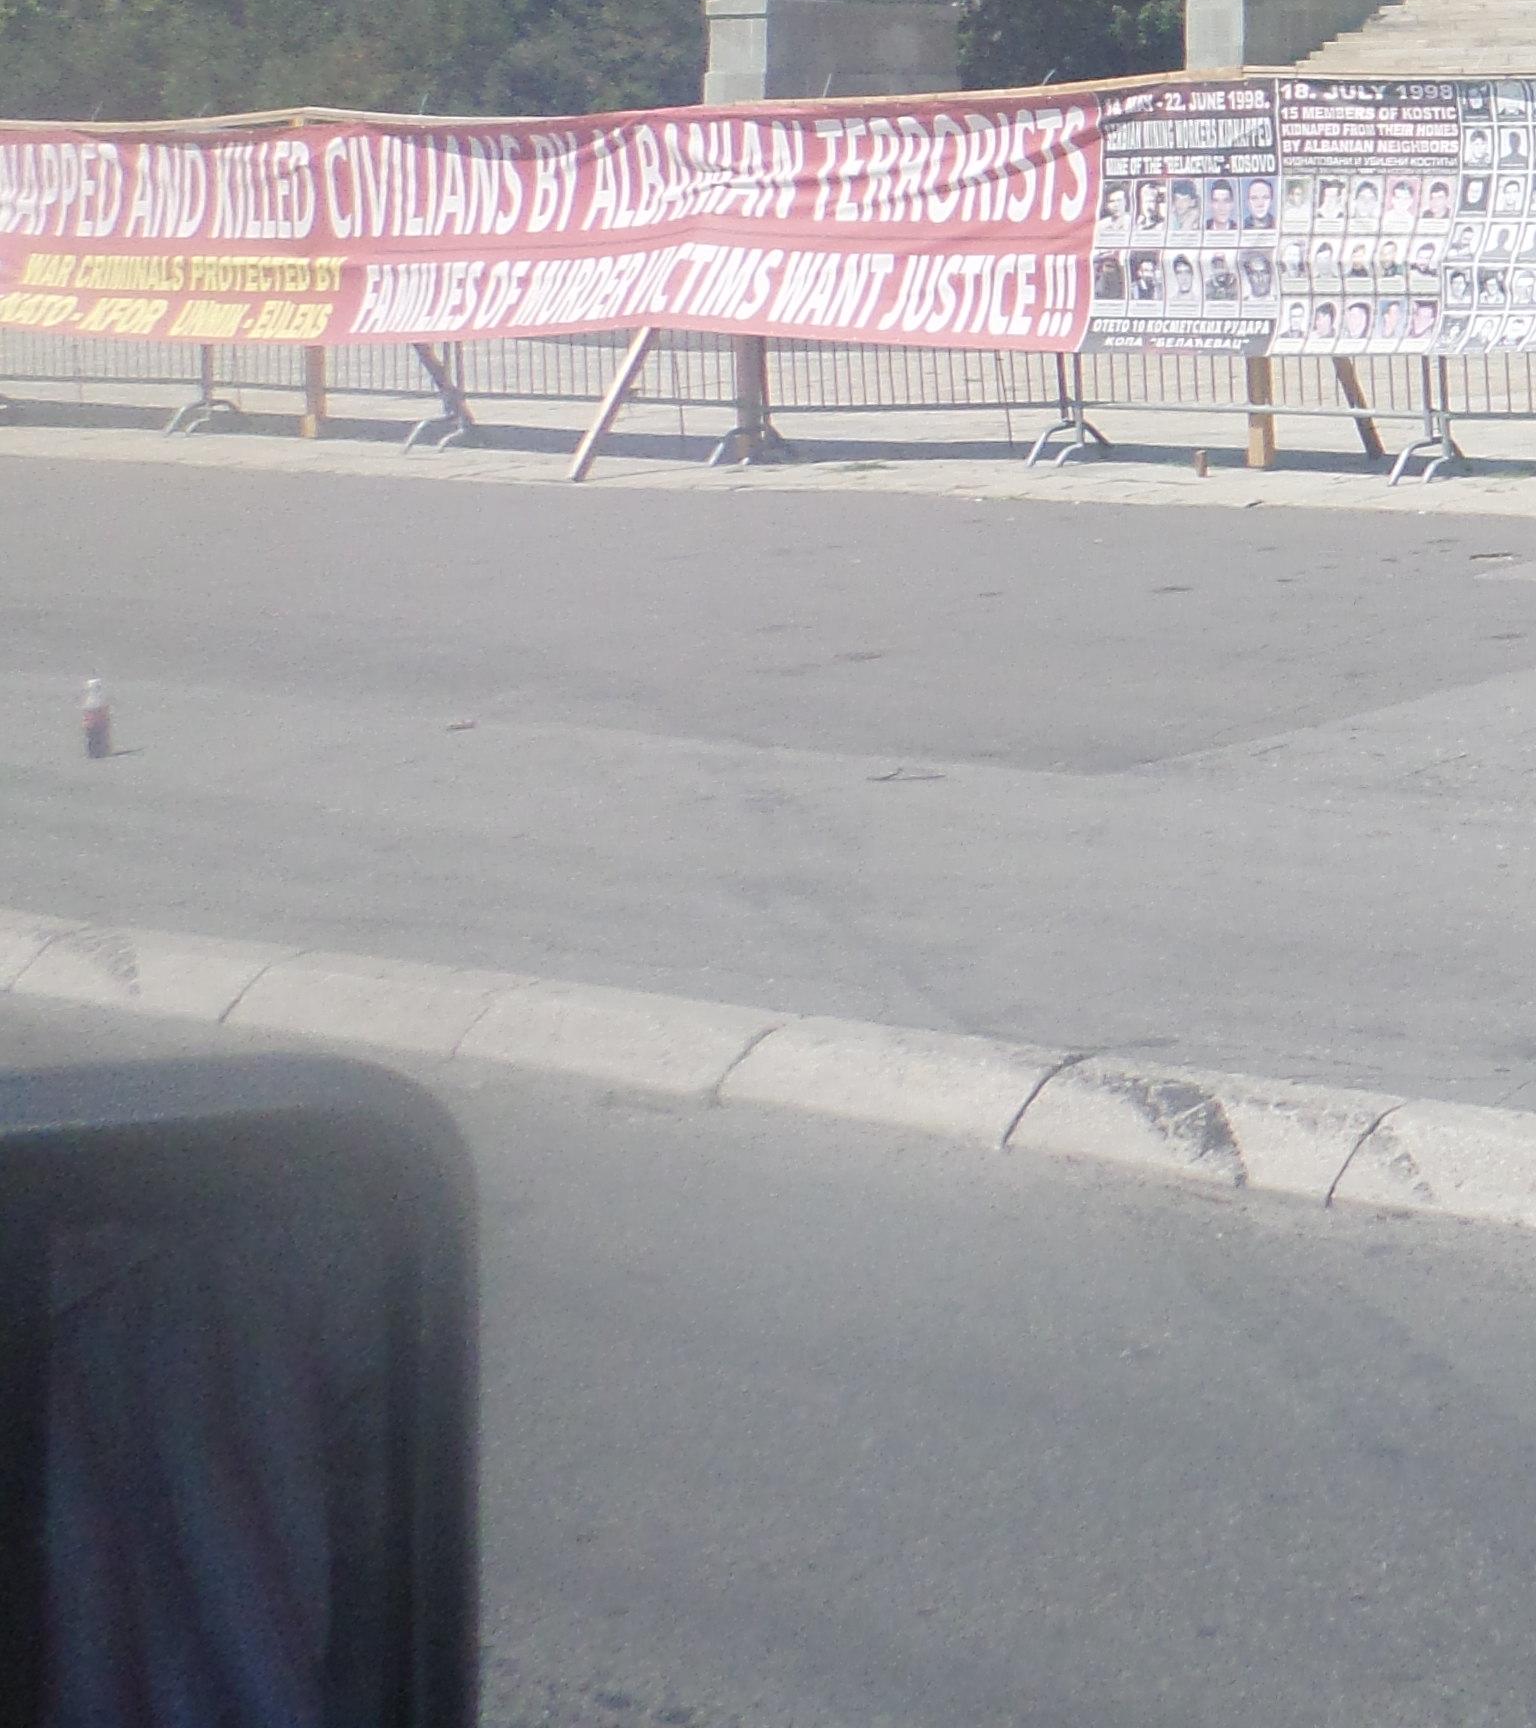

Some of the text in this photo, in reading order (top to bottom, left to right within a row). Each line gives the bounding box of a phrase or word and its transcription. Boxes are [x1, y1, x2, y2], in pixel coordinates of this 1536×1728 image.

[1164, 92, 1186, 111] 22.
[1188, 91, 1226, 111] JUNE
[1227, 89, 1270, 110] 1998.
[1281, 83, 1454, 101] 18. JULY 1998
[1281, 106, 1457, 121] 15 MEMBERS OF KOSTIC
[1343, 123, 1376, 136] FROM
[1376, 124, 1414, 136] THEIR
[1415, 124, 1459, 136] HOMES
[1282, 140, 1459, 153] BY ALBANIAN NEIGHBORS
[124, 142, 207, 238] AND
[208, 140, 316, 239] KILLED
[324, 134, 523, 239] CIVILIANS
[526, 131, 578, 234] BY
[580, 120, 803, 231] ALBANIAN
[813, 106, 1088, 223] TERRORISTS
[1130, 157, 1142, 176] OF
[1142, 156, 1162, 175] THE
[1230, 154, 1276, 174] KOSOVO
[21, 253, 348, 292] WAR CRIMINALS PROTECTED BY
[350, 242, 1078, 336] FAMILIES OF MURDER VICTIMS WANT JUSTICE !!!
[1093, 318, 1270, 336] ОТЕТО 10 КОСМЕТСКИХ РУДАРА
[1104, 336, 1144, 347] КОПА
